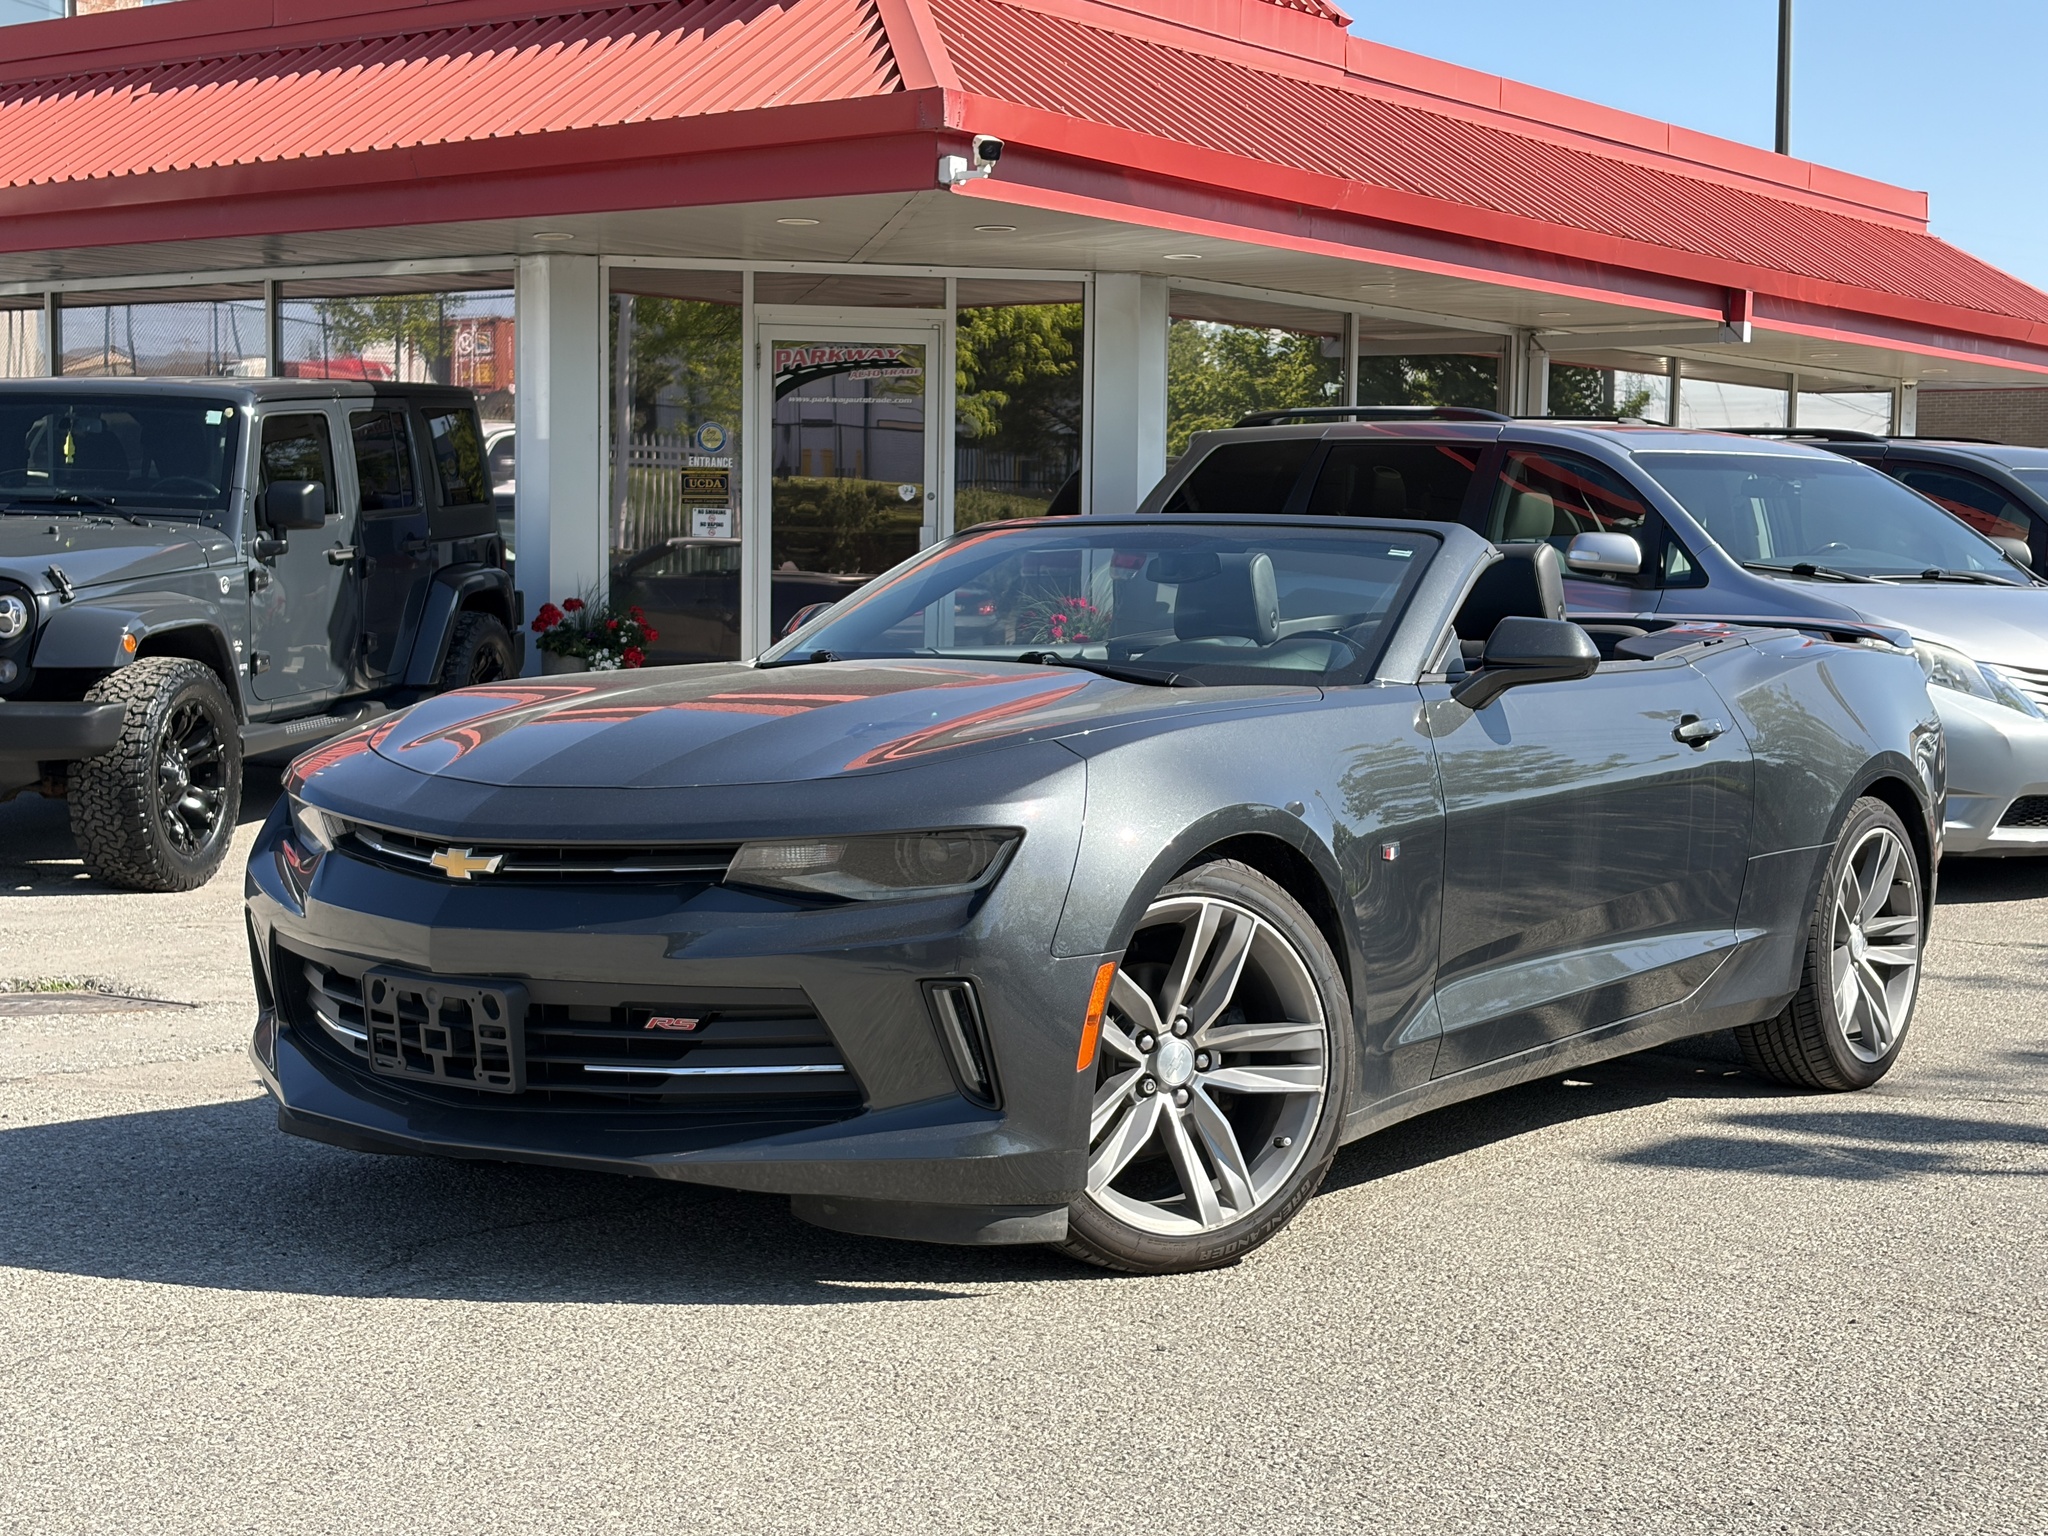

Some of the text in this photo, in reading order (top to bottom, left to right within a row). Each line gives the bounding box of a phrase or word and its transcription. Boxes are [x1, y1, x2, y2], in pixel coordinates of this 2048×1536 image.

[776, 348, 904, 372] PARKWAY
[849, 367, 922, 381] AUTO TRADE
[788, 396, 913, 404] www.parkwayautotrade.com
[689, 456, 733, 468] ENTRANCE
[689, 479, 722, 488] UCDA
[644, 1016, 699, 1031] RS
[1200, 1179, 1311, 1260] GRENLANDER
